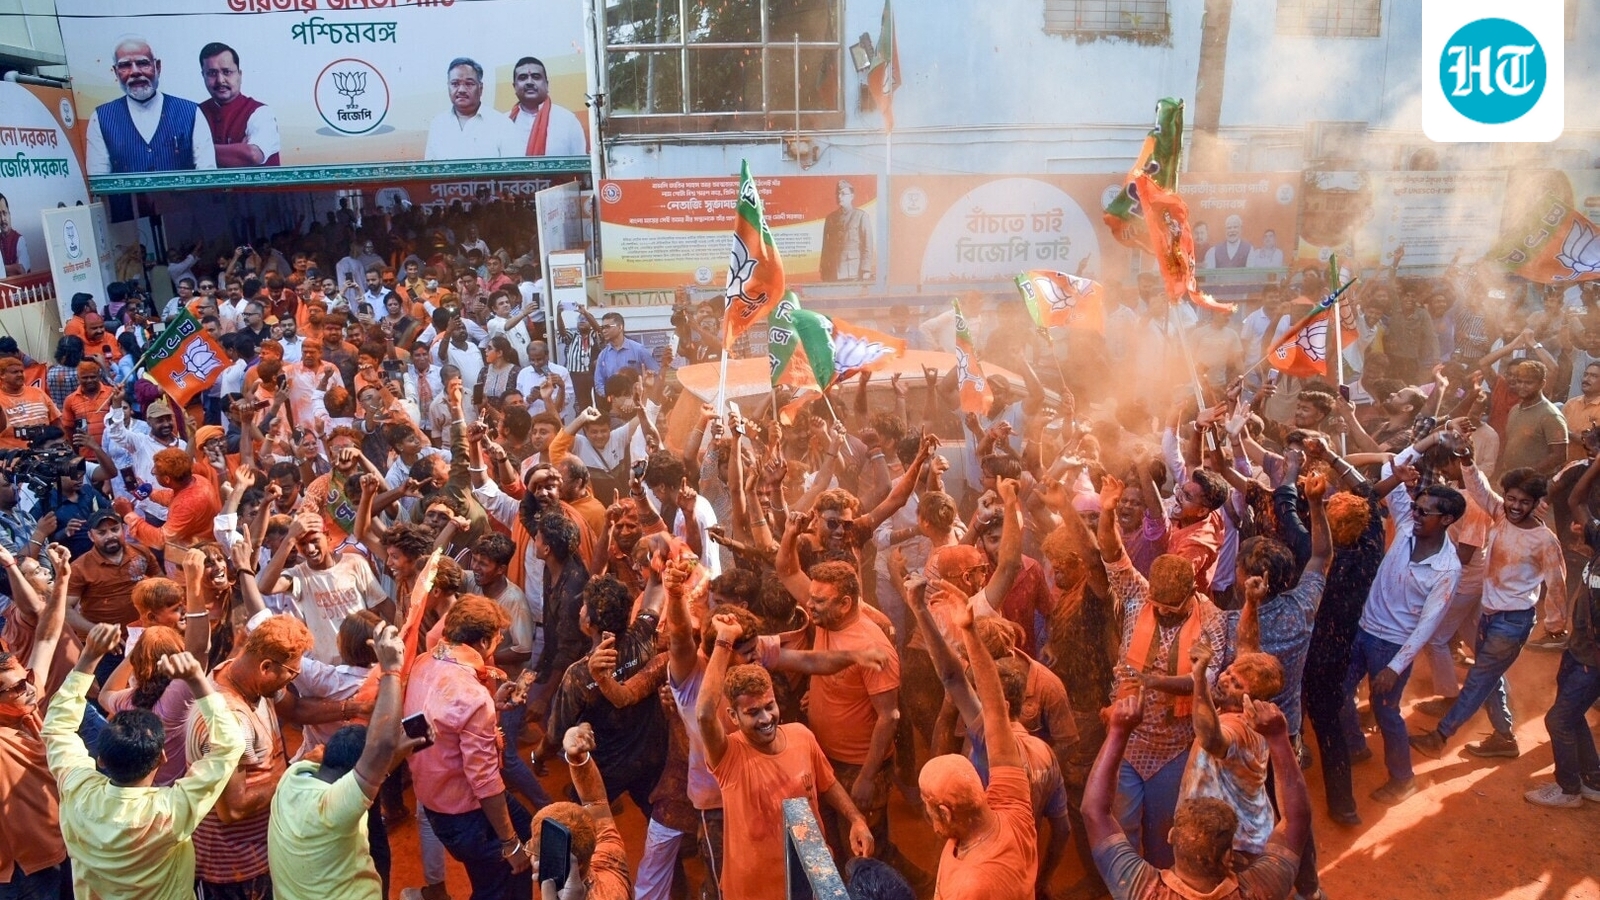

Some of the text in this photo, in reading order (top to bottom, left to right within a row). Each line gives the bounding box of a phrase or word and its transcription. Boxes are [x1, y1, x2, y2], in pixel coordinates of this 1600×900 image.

[291, 16, 398, 45] পশ্চিমবঙ্গ
[337, 108, 372, 121] বিজেপি
[18, 128, 58, 149] দরকার
[0, 152, 70, 179] জেপি সরকার
[704, 198, 738, 213] সুভাষচ
[965, 207, 1065, 234] বাঁচতে চাই
[955, 235, 1072, 263] বিজেপি তাই
[150, 318, 197, 360] BJP
